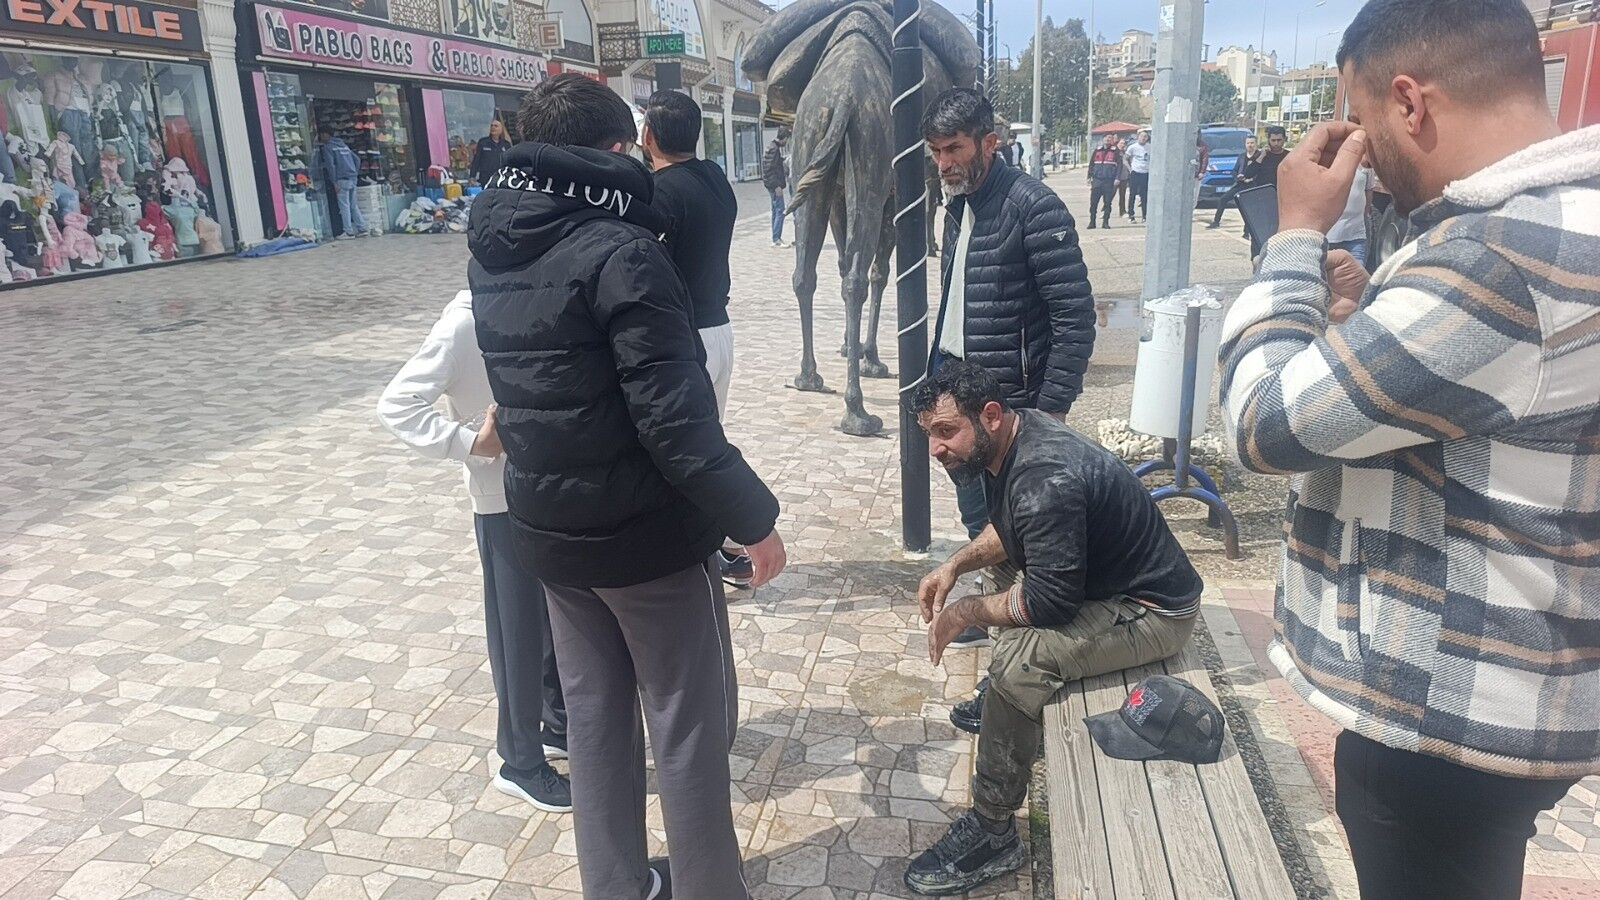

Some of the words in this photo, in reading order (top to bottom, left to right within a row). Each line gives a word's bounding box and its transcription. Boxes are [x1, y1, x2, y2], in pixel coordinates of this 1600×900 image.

[7, 0, 183, 40] EXTILE
[297, 23, 364, 60] PABLO
[370, 36, 413, 67] BAGS
[431, 39, 447, 73] &
[452, 49, 495, 76] PABLO
[499, 57, 536, 82] SHOES
